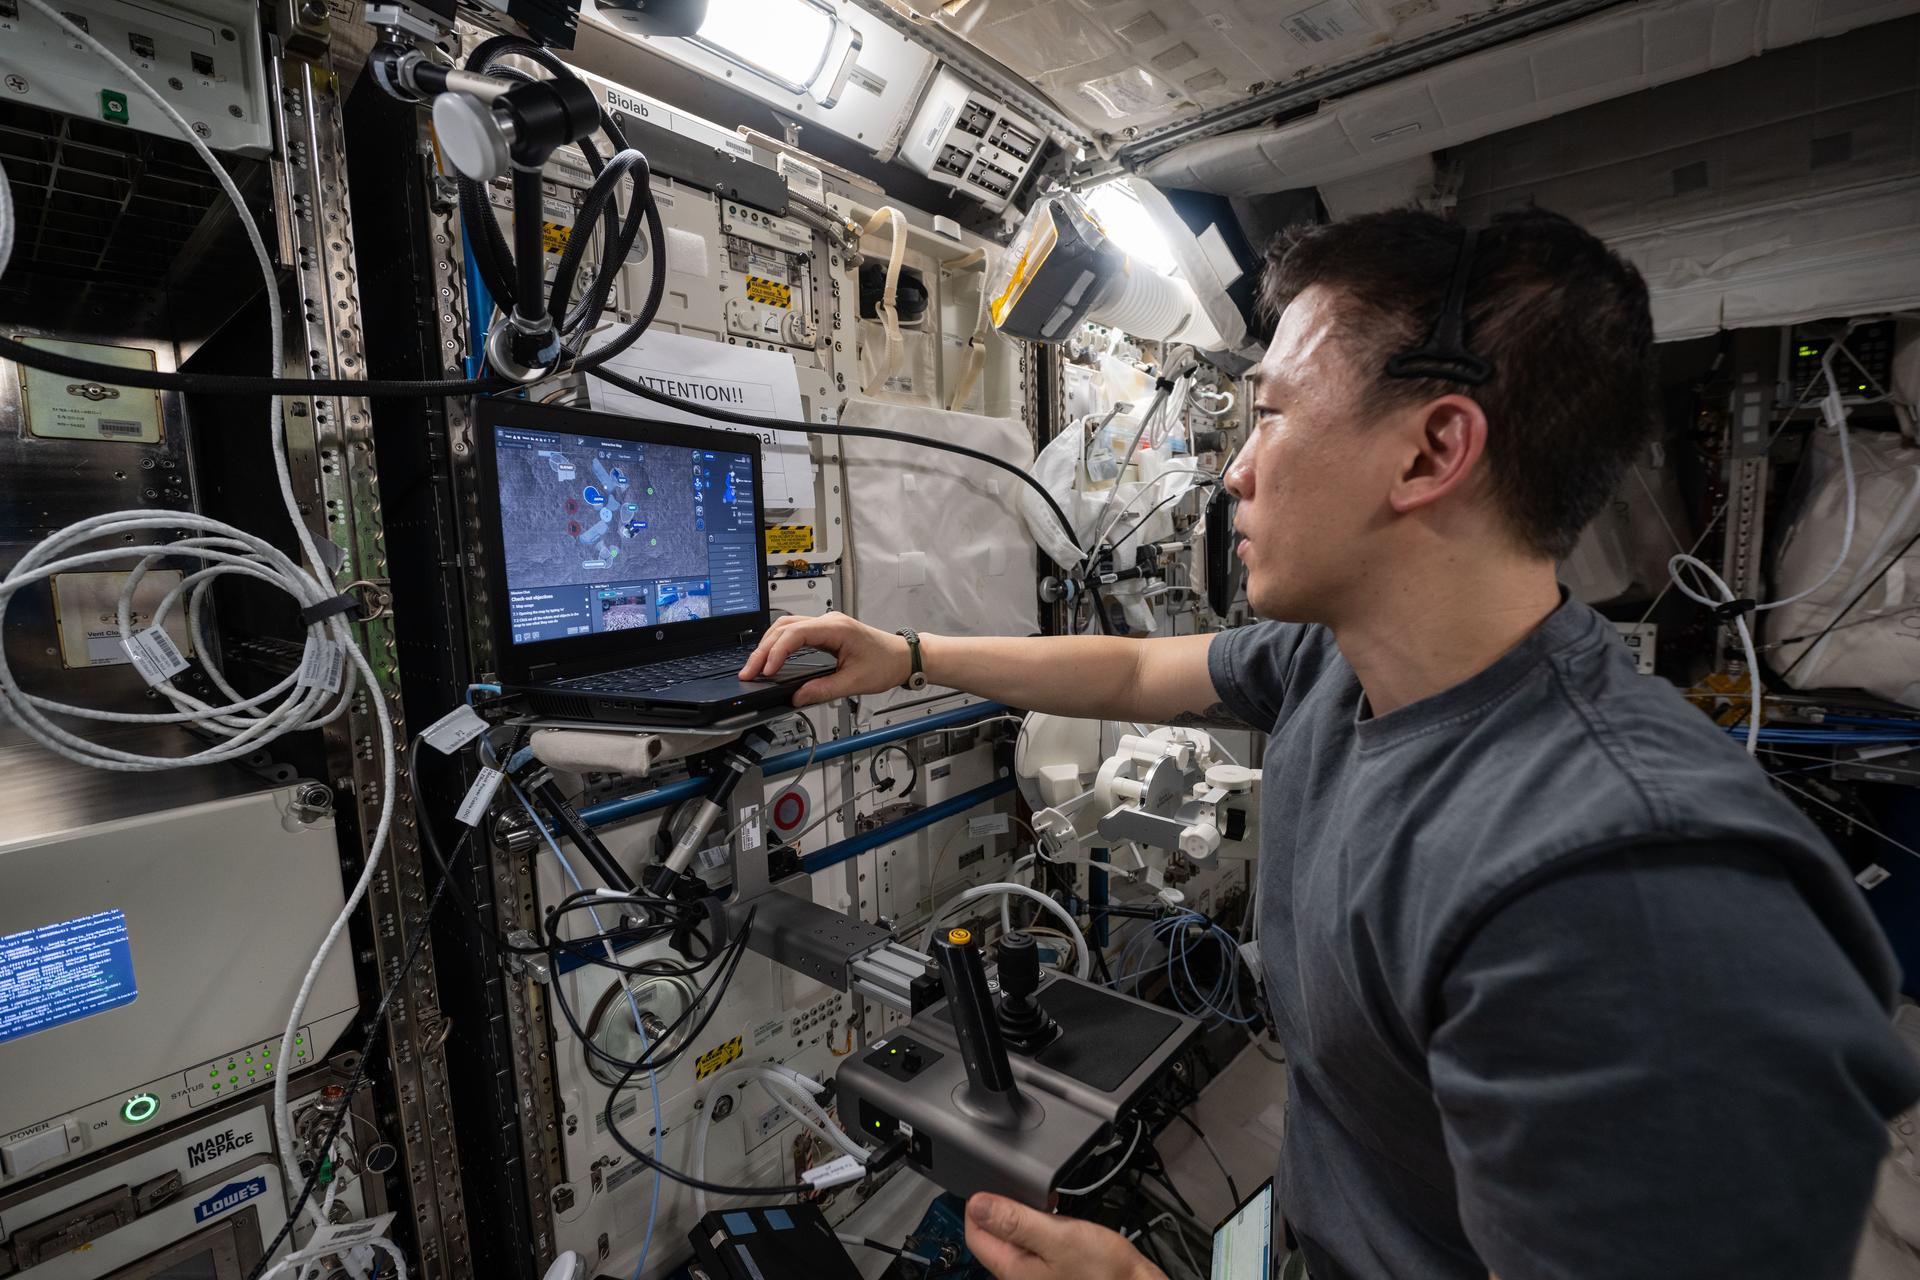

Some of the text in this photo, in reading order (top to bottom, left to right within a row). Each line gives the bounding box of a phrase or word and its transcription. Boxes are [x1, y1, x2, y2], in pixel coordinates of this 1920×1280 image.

[607, 90, 649, 118] Biolab
[637, 375, 744, 403] ATTENTION!!
[170, 1083, 204, 1100] STATUS
[9, 1122, 50, 1142] POWER
[93, 1120, 108, 1131] ON
[187, 1129, 236, 1156] MADE
[207, 1132, 254, 1160] SPACE
[201, 1183, 260, 1218] LOWE'S
